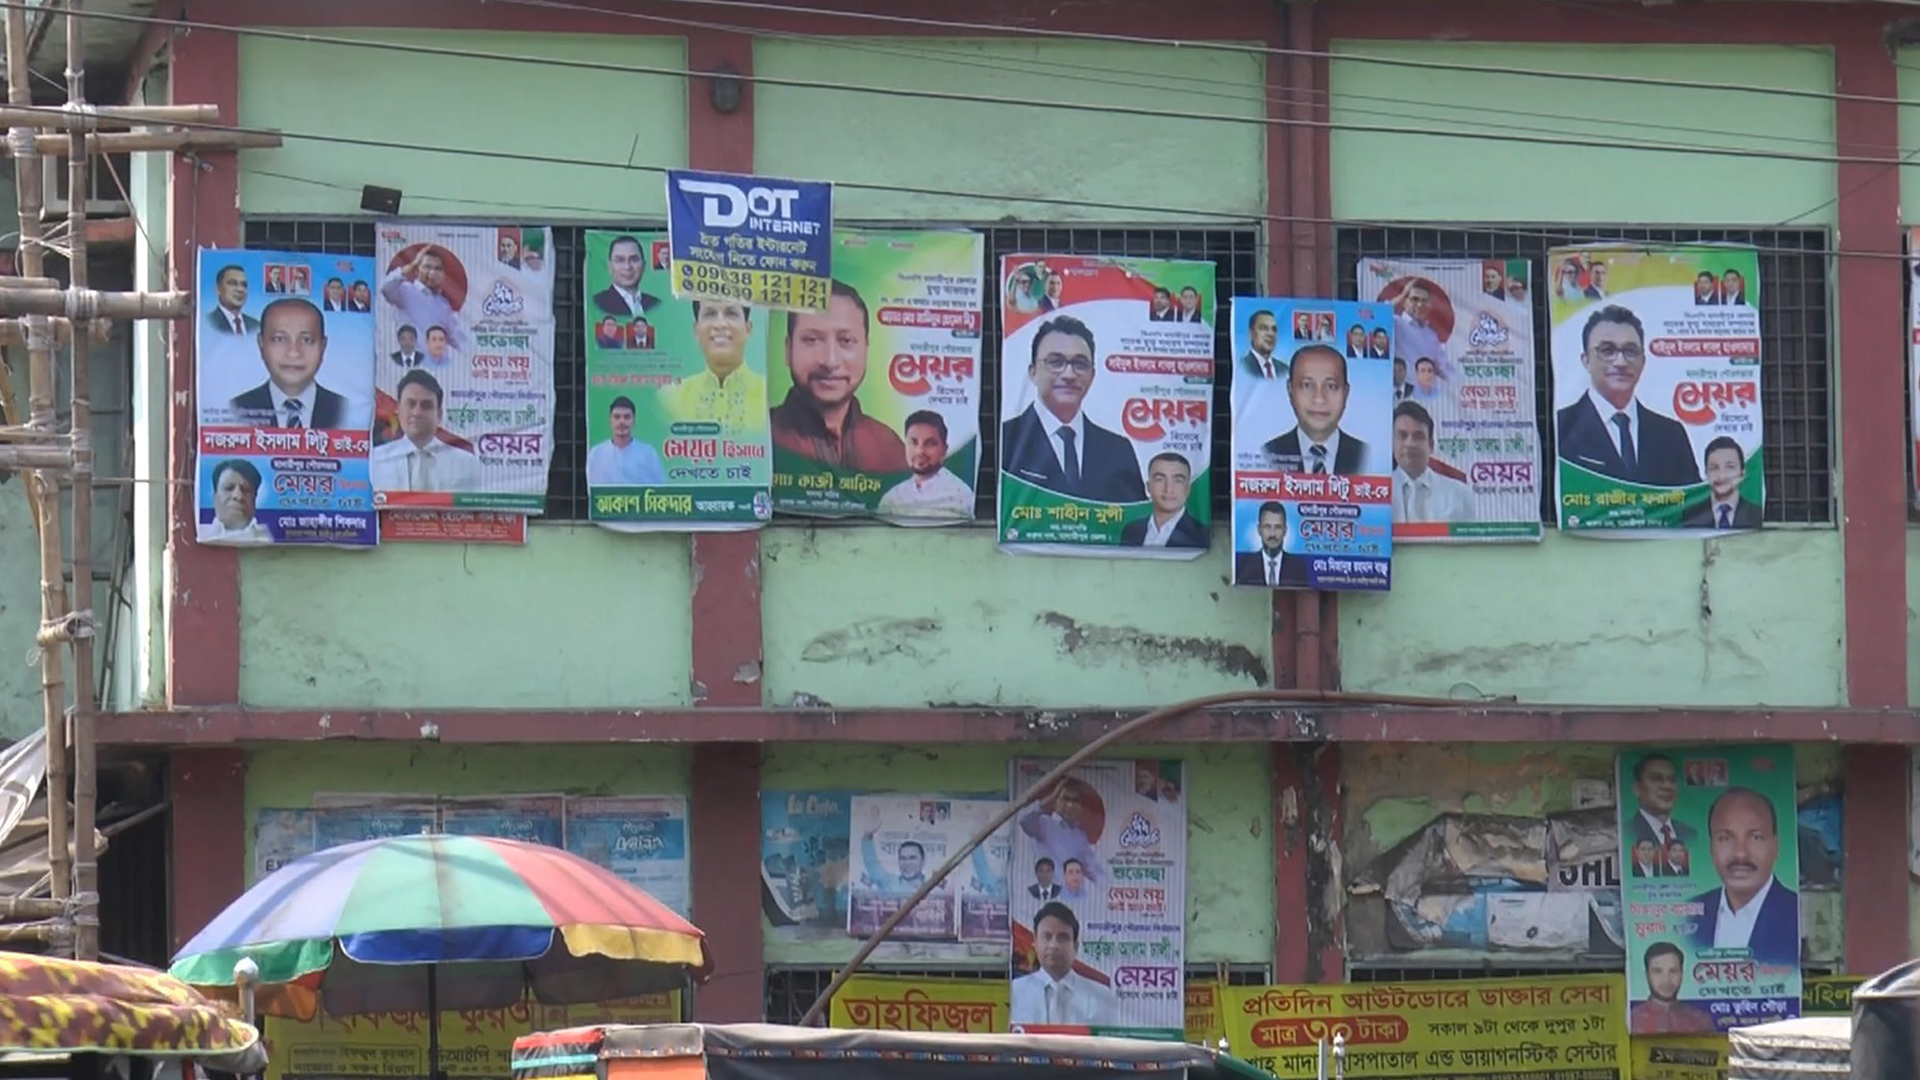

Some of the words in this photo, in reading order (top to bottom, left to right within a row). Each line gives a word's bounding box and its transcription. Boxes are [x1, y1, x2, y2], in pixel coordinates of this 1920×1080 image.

[678, 179, 799, 228] DOT
[750, 217, 821, 235] INTERNET
[759, 256, 786, 269] ফোন
[760, 274, 791, 289] 121
[800, 278, 826, 294] 121
[760, 289, 791, 304] 121
[800, 294, 826, 309] 121
[476, 335, 529, 350] শুভেচ্ছা
[472, 354, 502, 368] নেতা
[507, 356, 529, 369] নয়
[1462, 364, 1515, 380] শুভেচ্ছা
[888, 353, 974, 396] মেয়র
[1461, 385, 1490, 399] নেতা
[1495, 386, 1516, 401] নয়
[1673, 381, 1756, 425] মেয়র
[1121, 397, 1207, 441] মেয়র
[205, 431, 251, 449] নজরুল
[254, 428, 301, 451] ইসলাম
[478, 433, 543, 454] মেয়র
[664, 438, 717, 464] মেয়র
[669, 466, 720, 479] দেখতে
[726, 465, 751, 479] চাই
[798, 471, 833, 488] কাজী
[839, 473, 881, 493] আরিফ
[1471, 462, 1533, 483] মেয়র
[274, 473, 334, 495] মেয়র
[1238, 476, 1281, 494] নজরুল
[1284, 474, 1325, 496] ইসলাম
[595, 494, 640, 513] আকাশ
[645, 489, 692, 514] সিকদার
[1563, 493, 1591, 506] মোঃ
[1012, 504, 1042, 519] মোঃ
[1045, 503, 1090, 521] শাহীন
[1301, 519, 1355, 540] মেয়র
[1112, 866, 1165, 882] শুভেচ্ছা
[1109, 887, 1139, 901] নেতা
[1143, 888, 1165, 902] নয়
[1114, 966, 1178, 988] মেয়র
[1693, 961, 1755, 983] মেয়র
[1242, 989, 1333, 1016] প্রতিদিন
[1341, 985, 1470, 1011] আউটডোরে
[1478, 985, 1553, 1007] ডাক্তার
[1561, 982, 1611, 1004] সেবা
[1698, 985, 1752, 997] দেখতে
[1759, 983, 1785, 995] চাই
[842, 989, 997, 1033] তাহফিজুল
[1258, 1025, 1299, 1045] মাত্র
[1303, 1020, 1353, 1043] ৩০
[1355, 1017, 1400, 1041] টাকা
[1427, 1021, 1468, 1037] সকাল
[1473, 1018, 1498, 1036] ৯টা
[1503, 1019, 1539, 1035] থেকে
[1543, 1017, 1577, 1035] দুপুর
[1582, 1014, 1606, 1032] ১টা
[1282, 1053, 1320, 1073] মাদা
[1343, 1048, 1418, 1074] াসপাতাল
[1425, 1050, 1454, 1068] এন্ড
[1460, 1041, 1559, 1068] ডায়াগনস্টিক
[1565, 1040, 1618, 1064] সেন্টার
